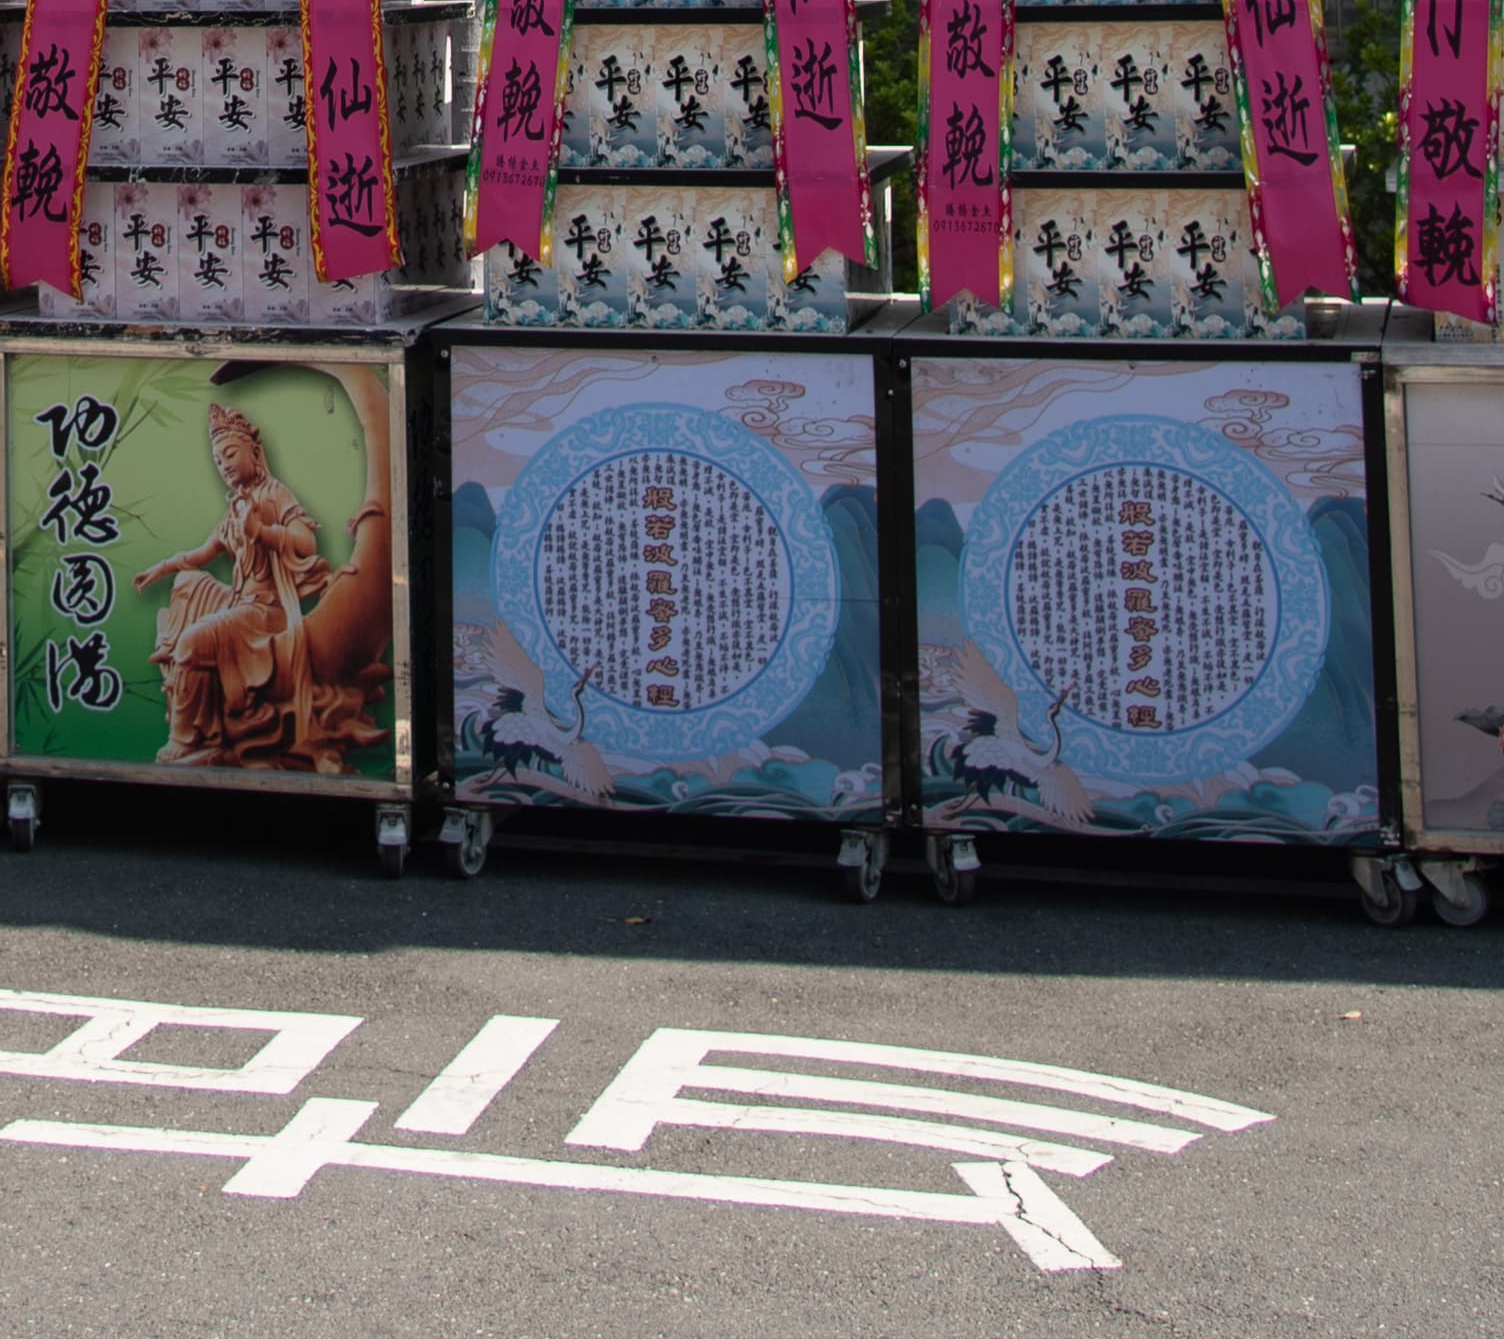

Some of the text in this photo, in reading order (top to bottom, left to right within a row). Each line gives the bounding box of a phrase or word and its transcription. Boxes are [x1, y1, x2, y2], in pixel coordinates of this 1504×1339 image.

[595, 54, 640, 131] 平安
[663, 55, 708, 132] 平安
[1112, 55, 1157, 132] 平安
[13, 44, 79, 226] 敬輓
[124, 216, 164, 284] 平安
[565, 213, 610, 290] 平安
[634, 214, 679, 291] 平安
[704, 216, 749, 293] 平安
[1035, 220, 1080, 297] 平安
[1176, 217, 1227, 302] 平安
[644, 487, 678, 708] 般若波羅蜜多心經
[1119, 500, 1162, 729] 般若波羅蜜多心經
